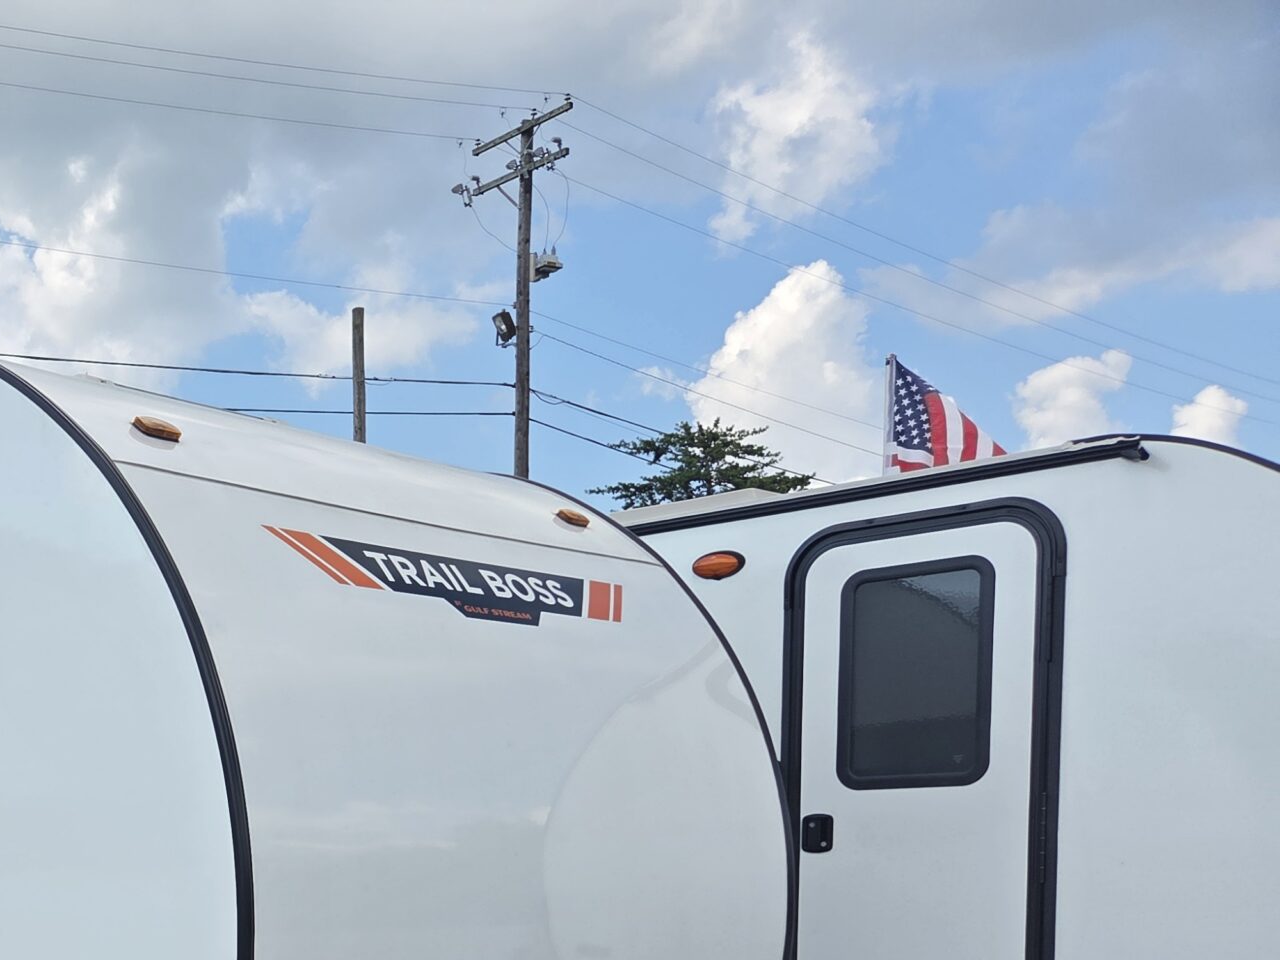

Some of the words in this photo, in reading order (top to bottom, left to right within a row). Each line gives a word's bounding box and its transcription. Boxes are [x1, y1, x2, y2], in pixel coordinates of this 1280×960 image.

[363, 551, 485, 596] TRAIL
[478, 569, 575, 608] BOSS
[464, 605, 489, 615] GULF
[491, 608, 532, 620] STREAM
